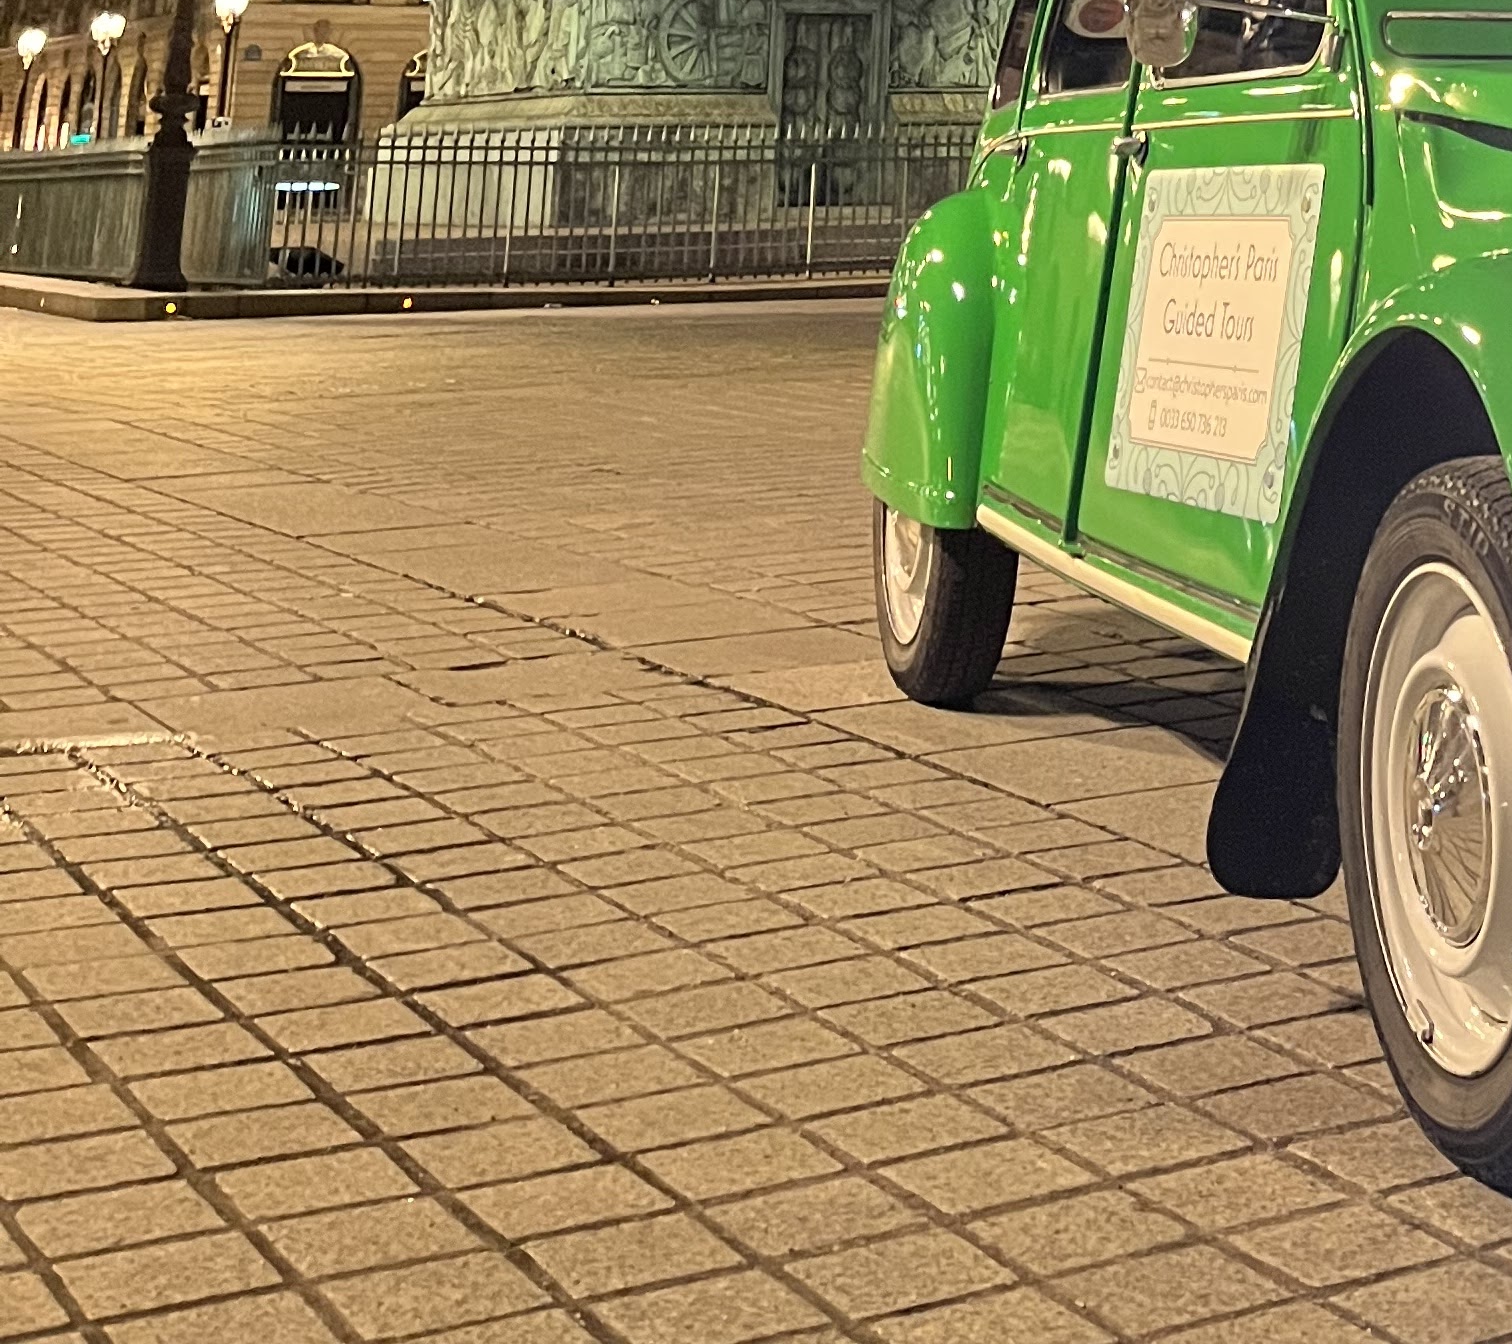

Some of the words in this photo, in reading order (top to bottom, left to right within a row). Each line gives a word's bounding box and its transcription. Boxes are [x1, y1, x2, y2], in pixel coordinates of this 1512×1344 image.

[1159, 241, 1241, 289] Christopher's
[1243, 244, 1279, 283] Paris
[1163, 298, 1217, 338] Guided
[1220, 301, 1255, 343] Tours
[1160, 407, 1180, 430] 0033
[1180, 410, 1197, 432] 650
[1197, 413, 1212, 436] 736
